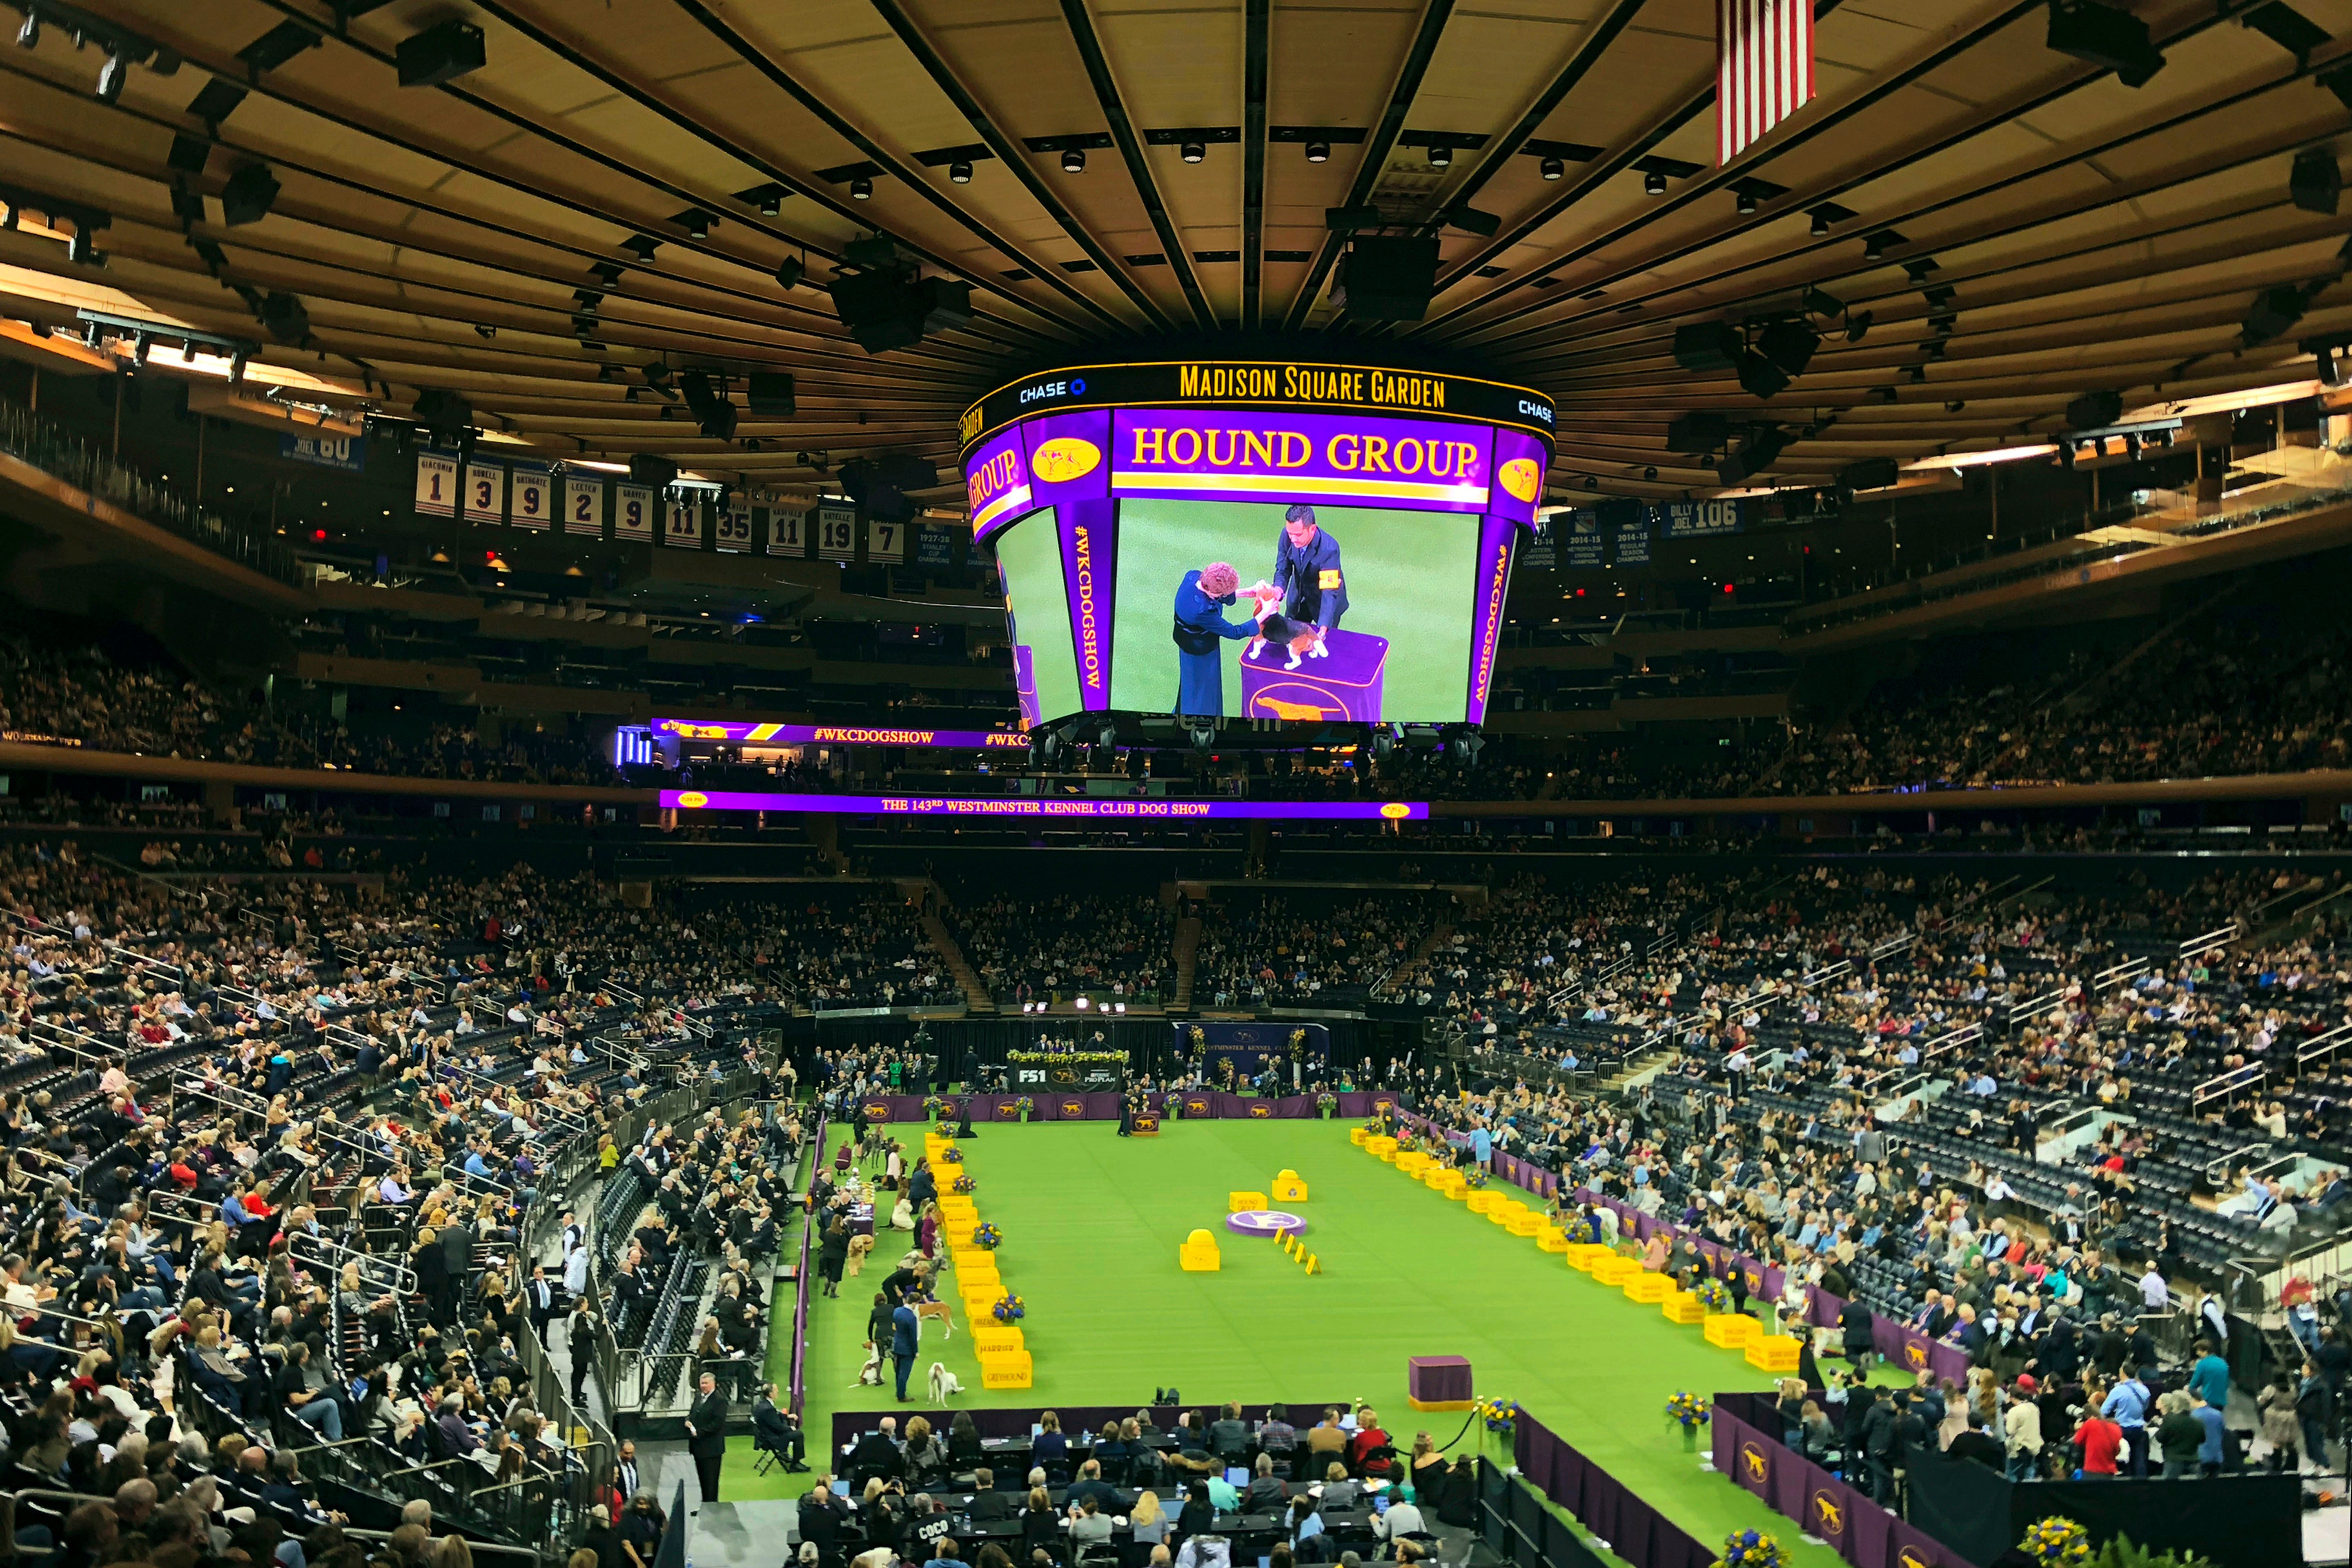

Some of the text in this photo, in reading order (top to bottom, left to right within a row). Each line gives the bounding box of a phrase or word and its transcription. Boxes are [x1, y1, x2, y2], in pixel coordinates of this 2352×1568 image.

[1020, 381, 1066, 403] CHASE
[1180, 365, 1444, 408] MADISON SQUARE GARDEN
[1519, 400, 1552, 423] CHASE
[963, 405, 983, 444] GARDEN
[1132, 428, 1477, 477] HOUND GROUP
[422, 461, 453, 473] GIACOMIN
[970, 449, 1016, 509] GROUP
[430, 473, 441, 501] 1
[476, 481, 492, 509] 3
[523, 488, 539, 514] 9
[576, 494, 591, 521] 2
[626, 501, 642, 527] 9
[672, 509, 695, 535] 11
[719, 512, 749, 539] 35
[1671, 500, 1736, 528] BILLY 106
[1672, 517, 1692, 530] JOEL
[776, 519, 798, 544] 11
[824, 523, 850, 548] 19
[879, 526, 894, 550] 7
[920, 534, 950, 543] 1927-28
[1570, 535, 1601, 544] 2014-15
[1617, 532, 1648, 542] 2014-15
[1074, 525, 1100, 689] #WKCDOGSHOW
[1476, 544, 1507, 704] #WKCDOGSHOW
[814, 728, 1031, 746] #WKCDOGSHOW #WKC
[882, 799, 908, 810] THE
[946, 801, 1040, 813] WESTMINSTER
[1044, 802, 1098, 814] KENNEL
[1100, 803, 1135, 814] CLUB
[1139, 804, 1168, 814] DOG
[1171, 804, 1210, 815] SHOW
[1019, 1069, 1046, 1082] FS1
[918, 1519, 949, 1540] COCO
